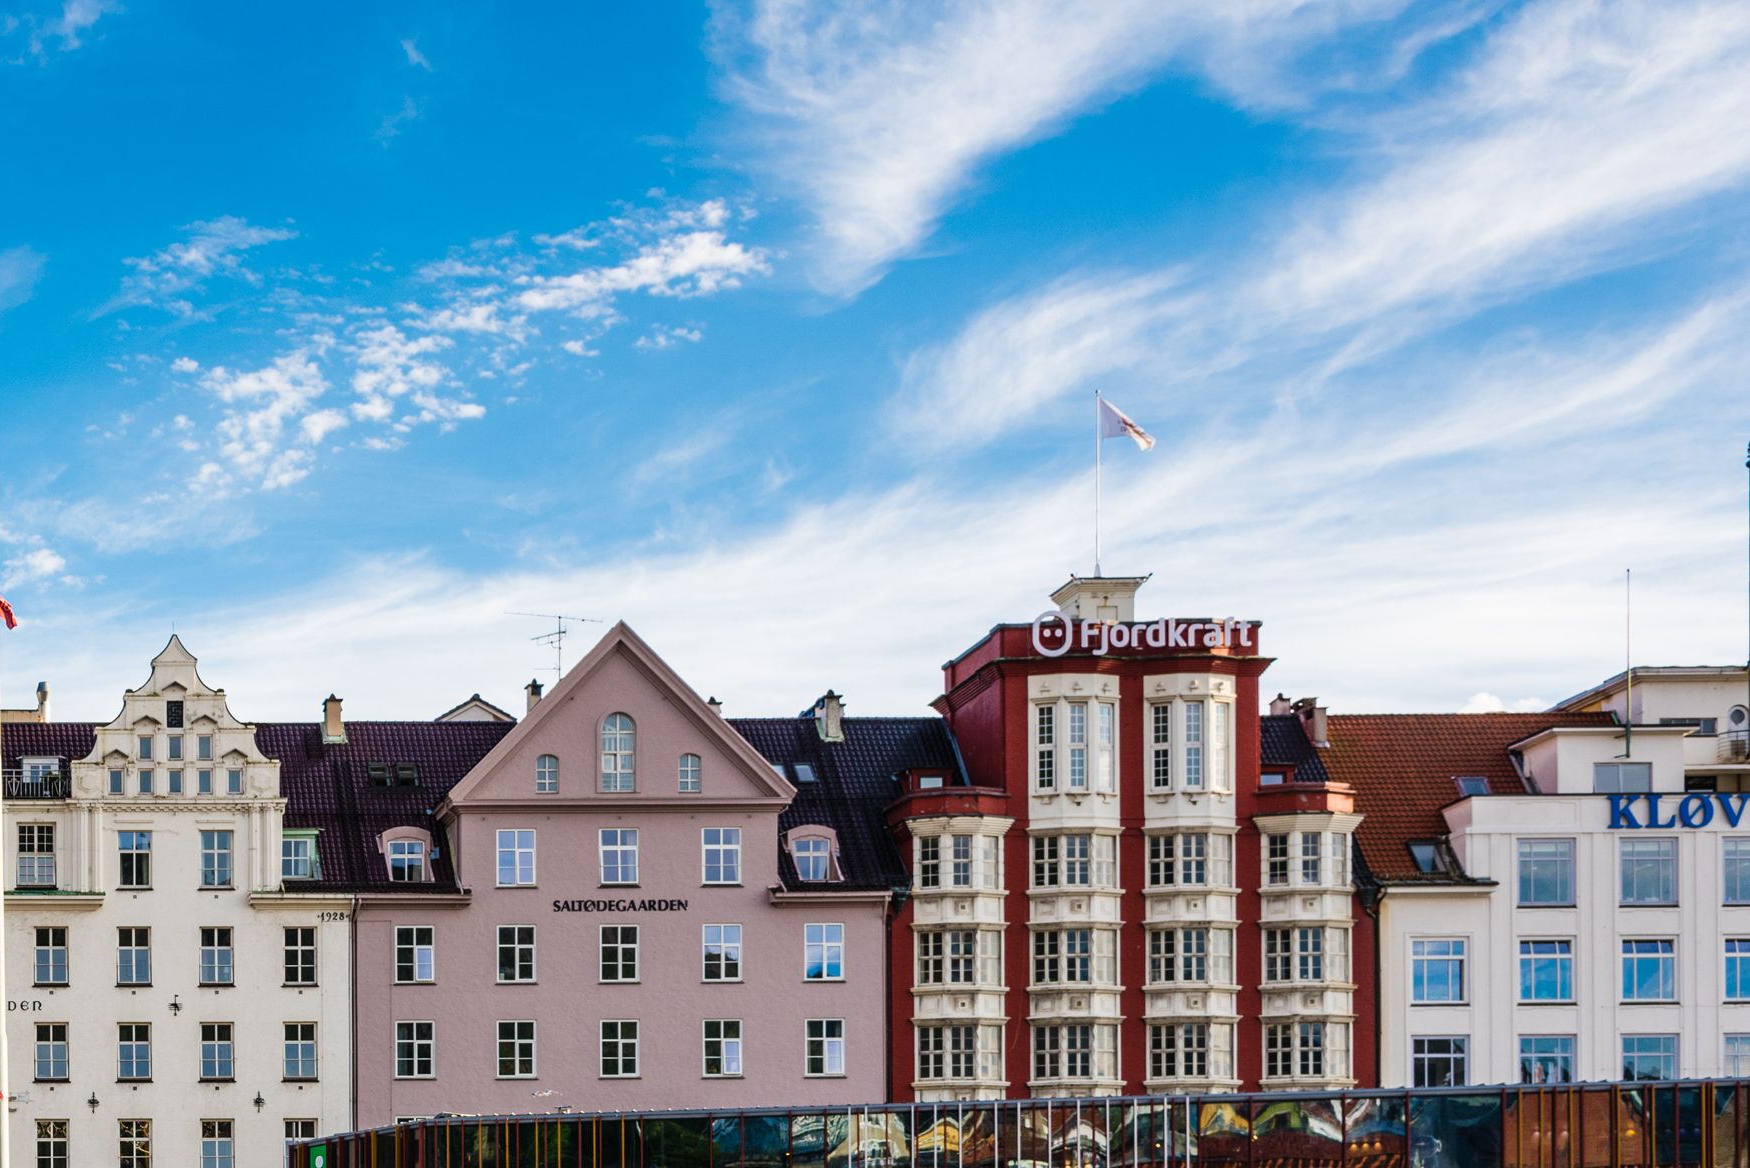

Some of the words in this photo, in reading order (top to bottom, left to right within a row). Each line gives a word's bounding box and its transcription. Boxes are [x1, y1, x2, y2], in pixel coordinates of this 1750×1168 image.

[1080, 616, 1252, 656] Fjordkraft
[1606, 793, 1750, 829] KLØV
[552, 899, 688, 913] SALTØDEGAARDEN
